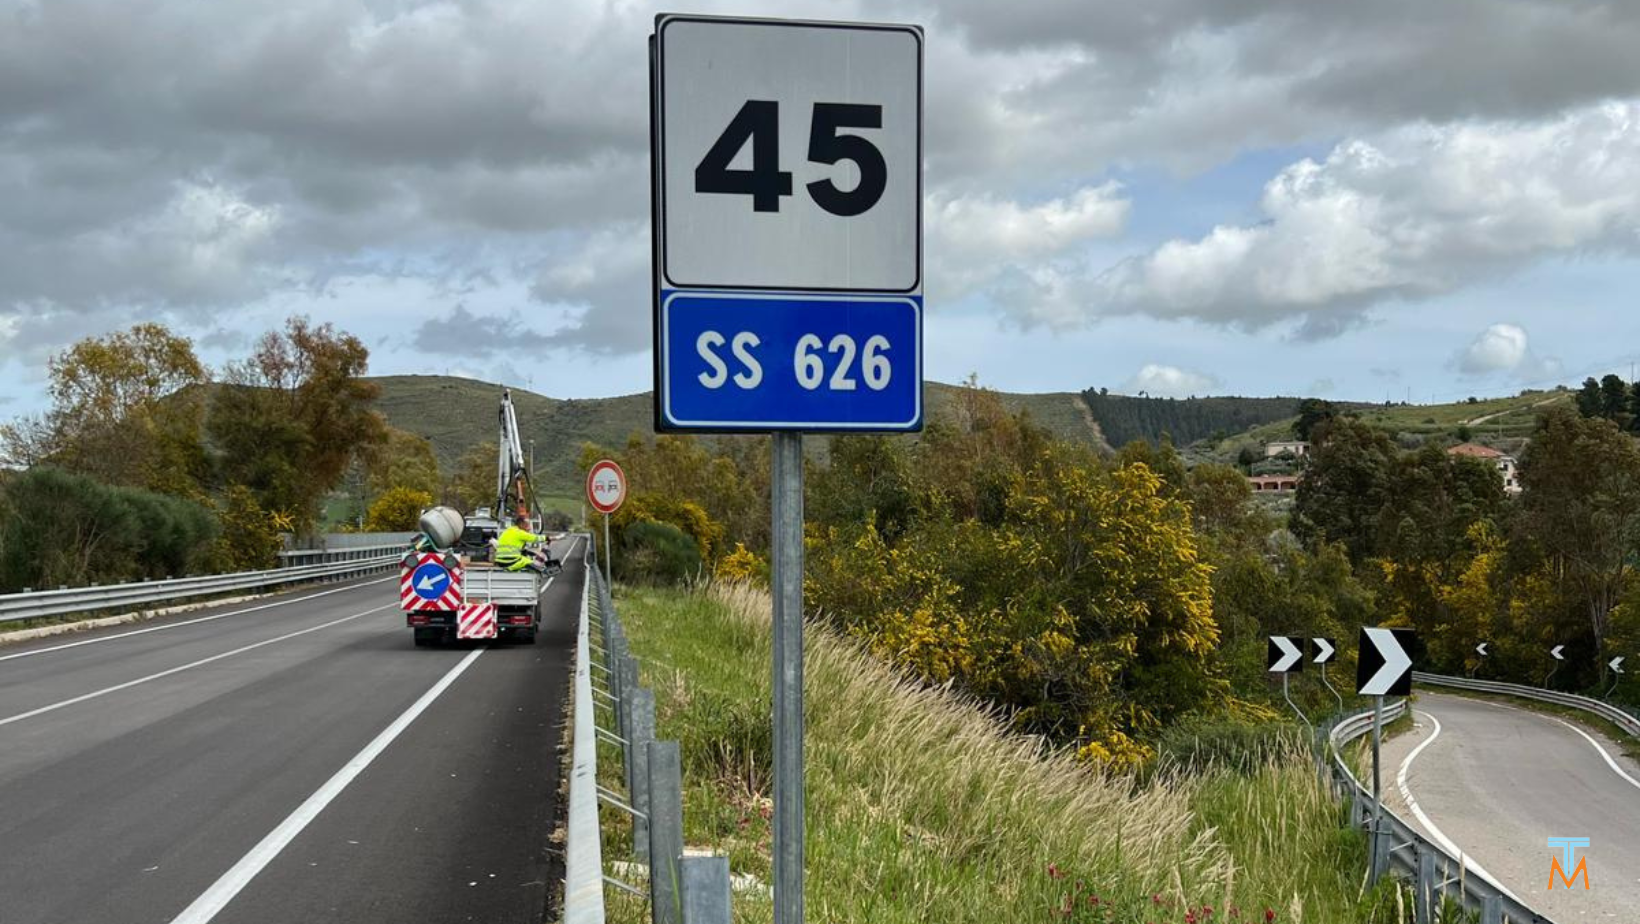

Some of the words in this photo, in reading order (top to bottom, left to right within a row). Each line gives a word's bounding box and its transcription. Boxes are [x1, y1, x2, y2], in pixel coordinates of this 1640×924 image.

[695, 99, 888, 217] 45
[696, 330, 763, 390] SS
[794, 332, 892, 392] 626
